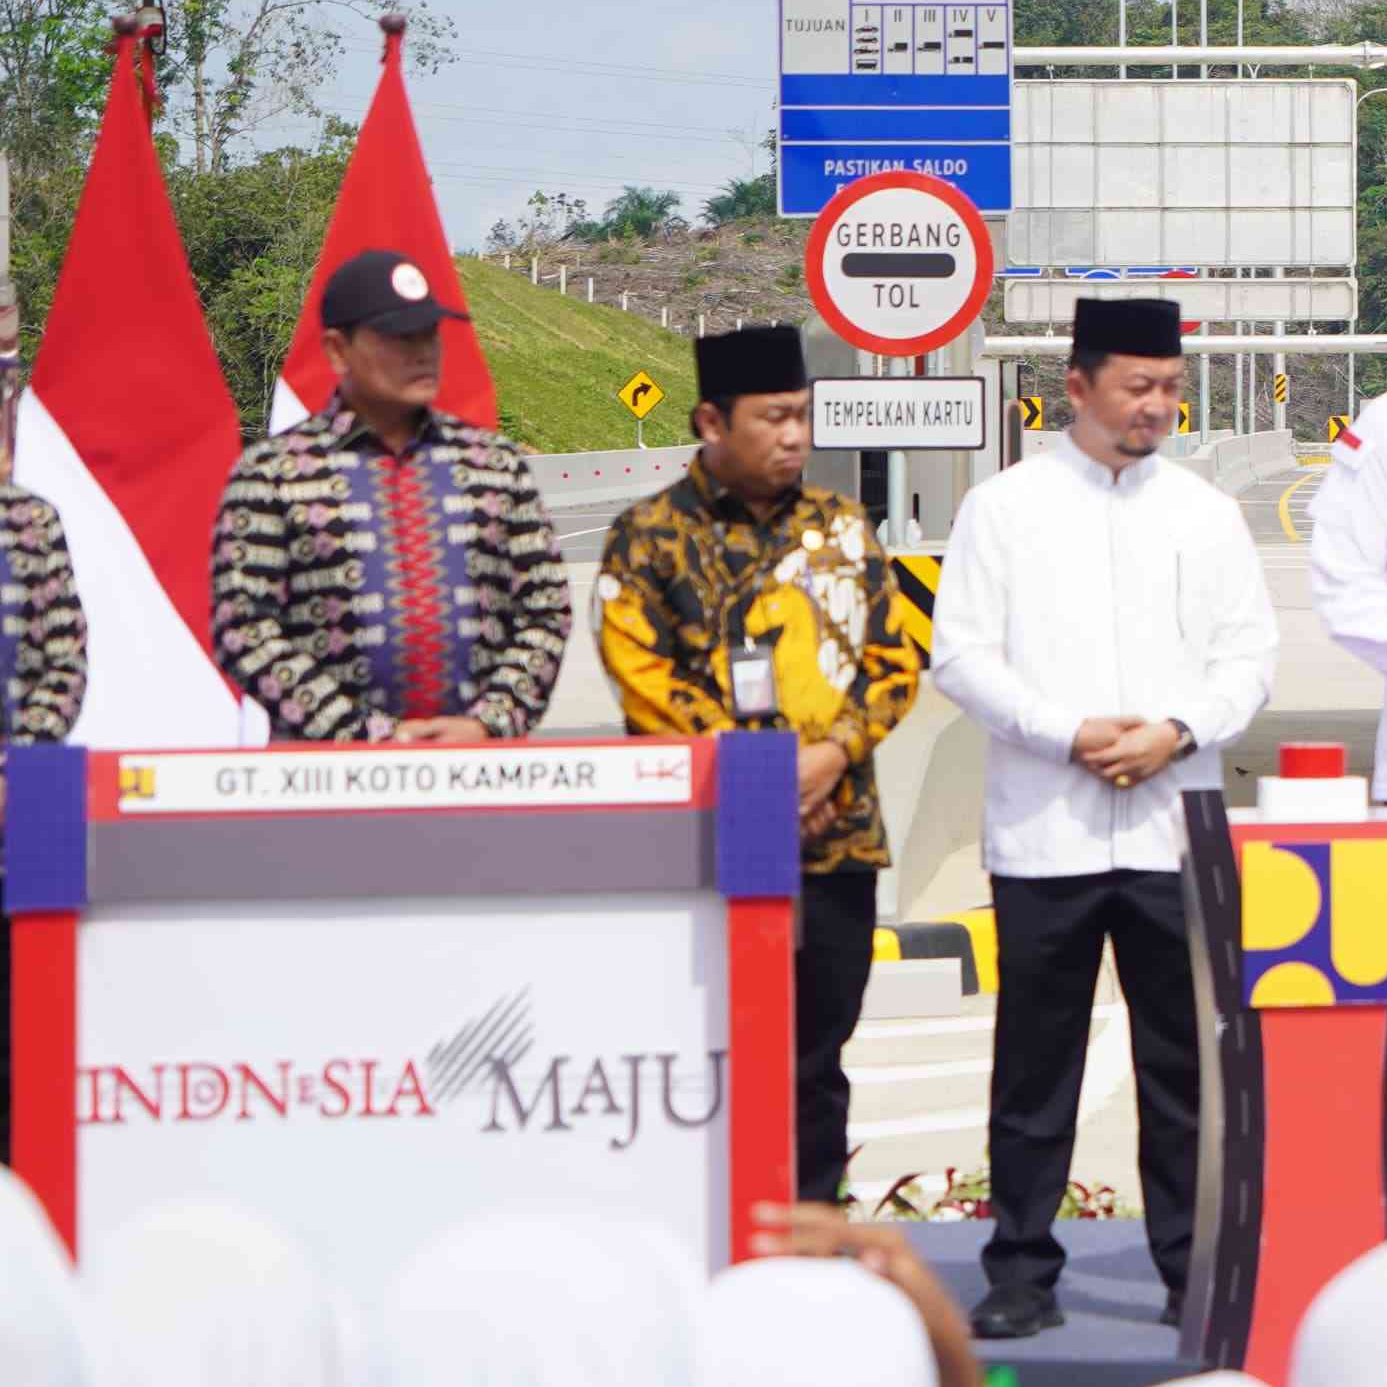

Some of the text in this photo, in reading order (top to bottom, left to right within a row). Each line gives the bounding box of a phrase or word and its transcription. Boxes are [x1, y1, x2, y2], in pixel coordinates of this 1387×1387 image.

[785, 19, 846, 32] TUJUAN
[824, 159, 968, 176] PASTIKAN SALDO
[836, 222, 961, 247] GERBANG
[873, 284, 920, 308] TOL
[824, 400, 973, 426] TEMPELKAN KARTU
[216, 767, 267, 795] GT.
[281, 767, 333, 794] XIII
[344, 764, 437, 792] KOTO
[450, 762, 595, 791] KAMPAR
[481, 1050, 728, 1150] MAJU
